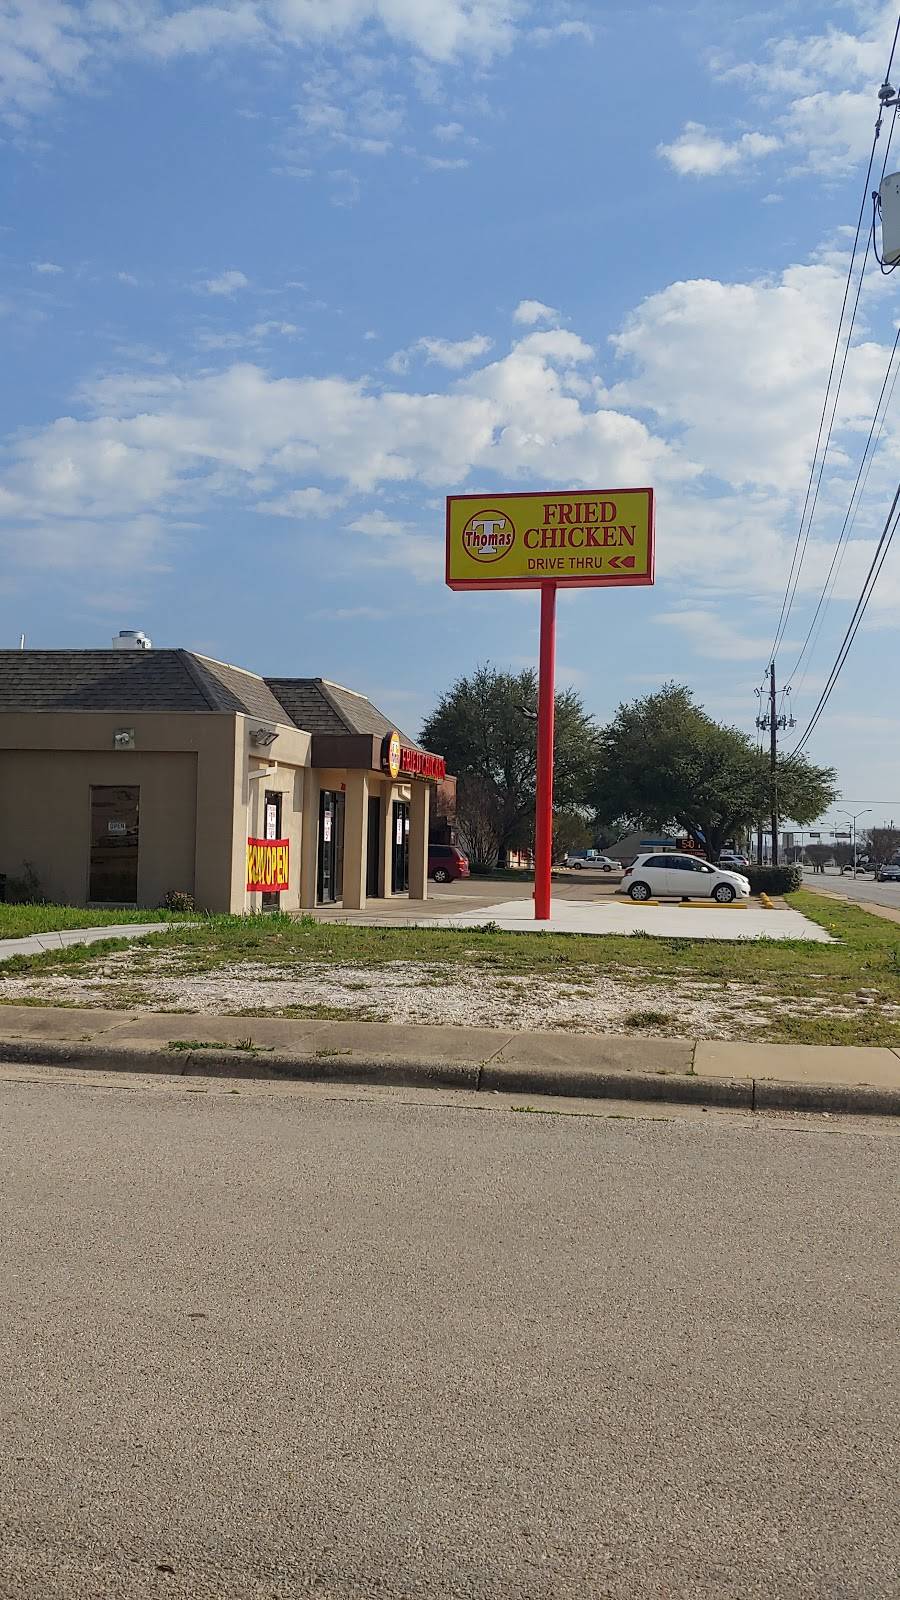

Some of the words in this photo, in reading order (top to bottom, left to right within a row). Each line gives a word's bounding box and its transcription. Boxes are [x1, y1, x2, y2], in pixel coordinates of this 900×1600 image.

[543, 501, 617, 525] FRIED
[465, 531, 511, 547] Thomas
[523, 525, 636, 549] CHICKEN
[528, 557, 565, 570] DRIVE
[568, 556, 602, 569] THRU
[402, 748, 422, 773] FRIED
[266, 846, 288, 884] OPEN
